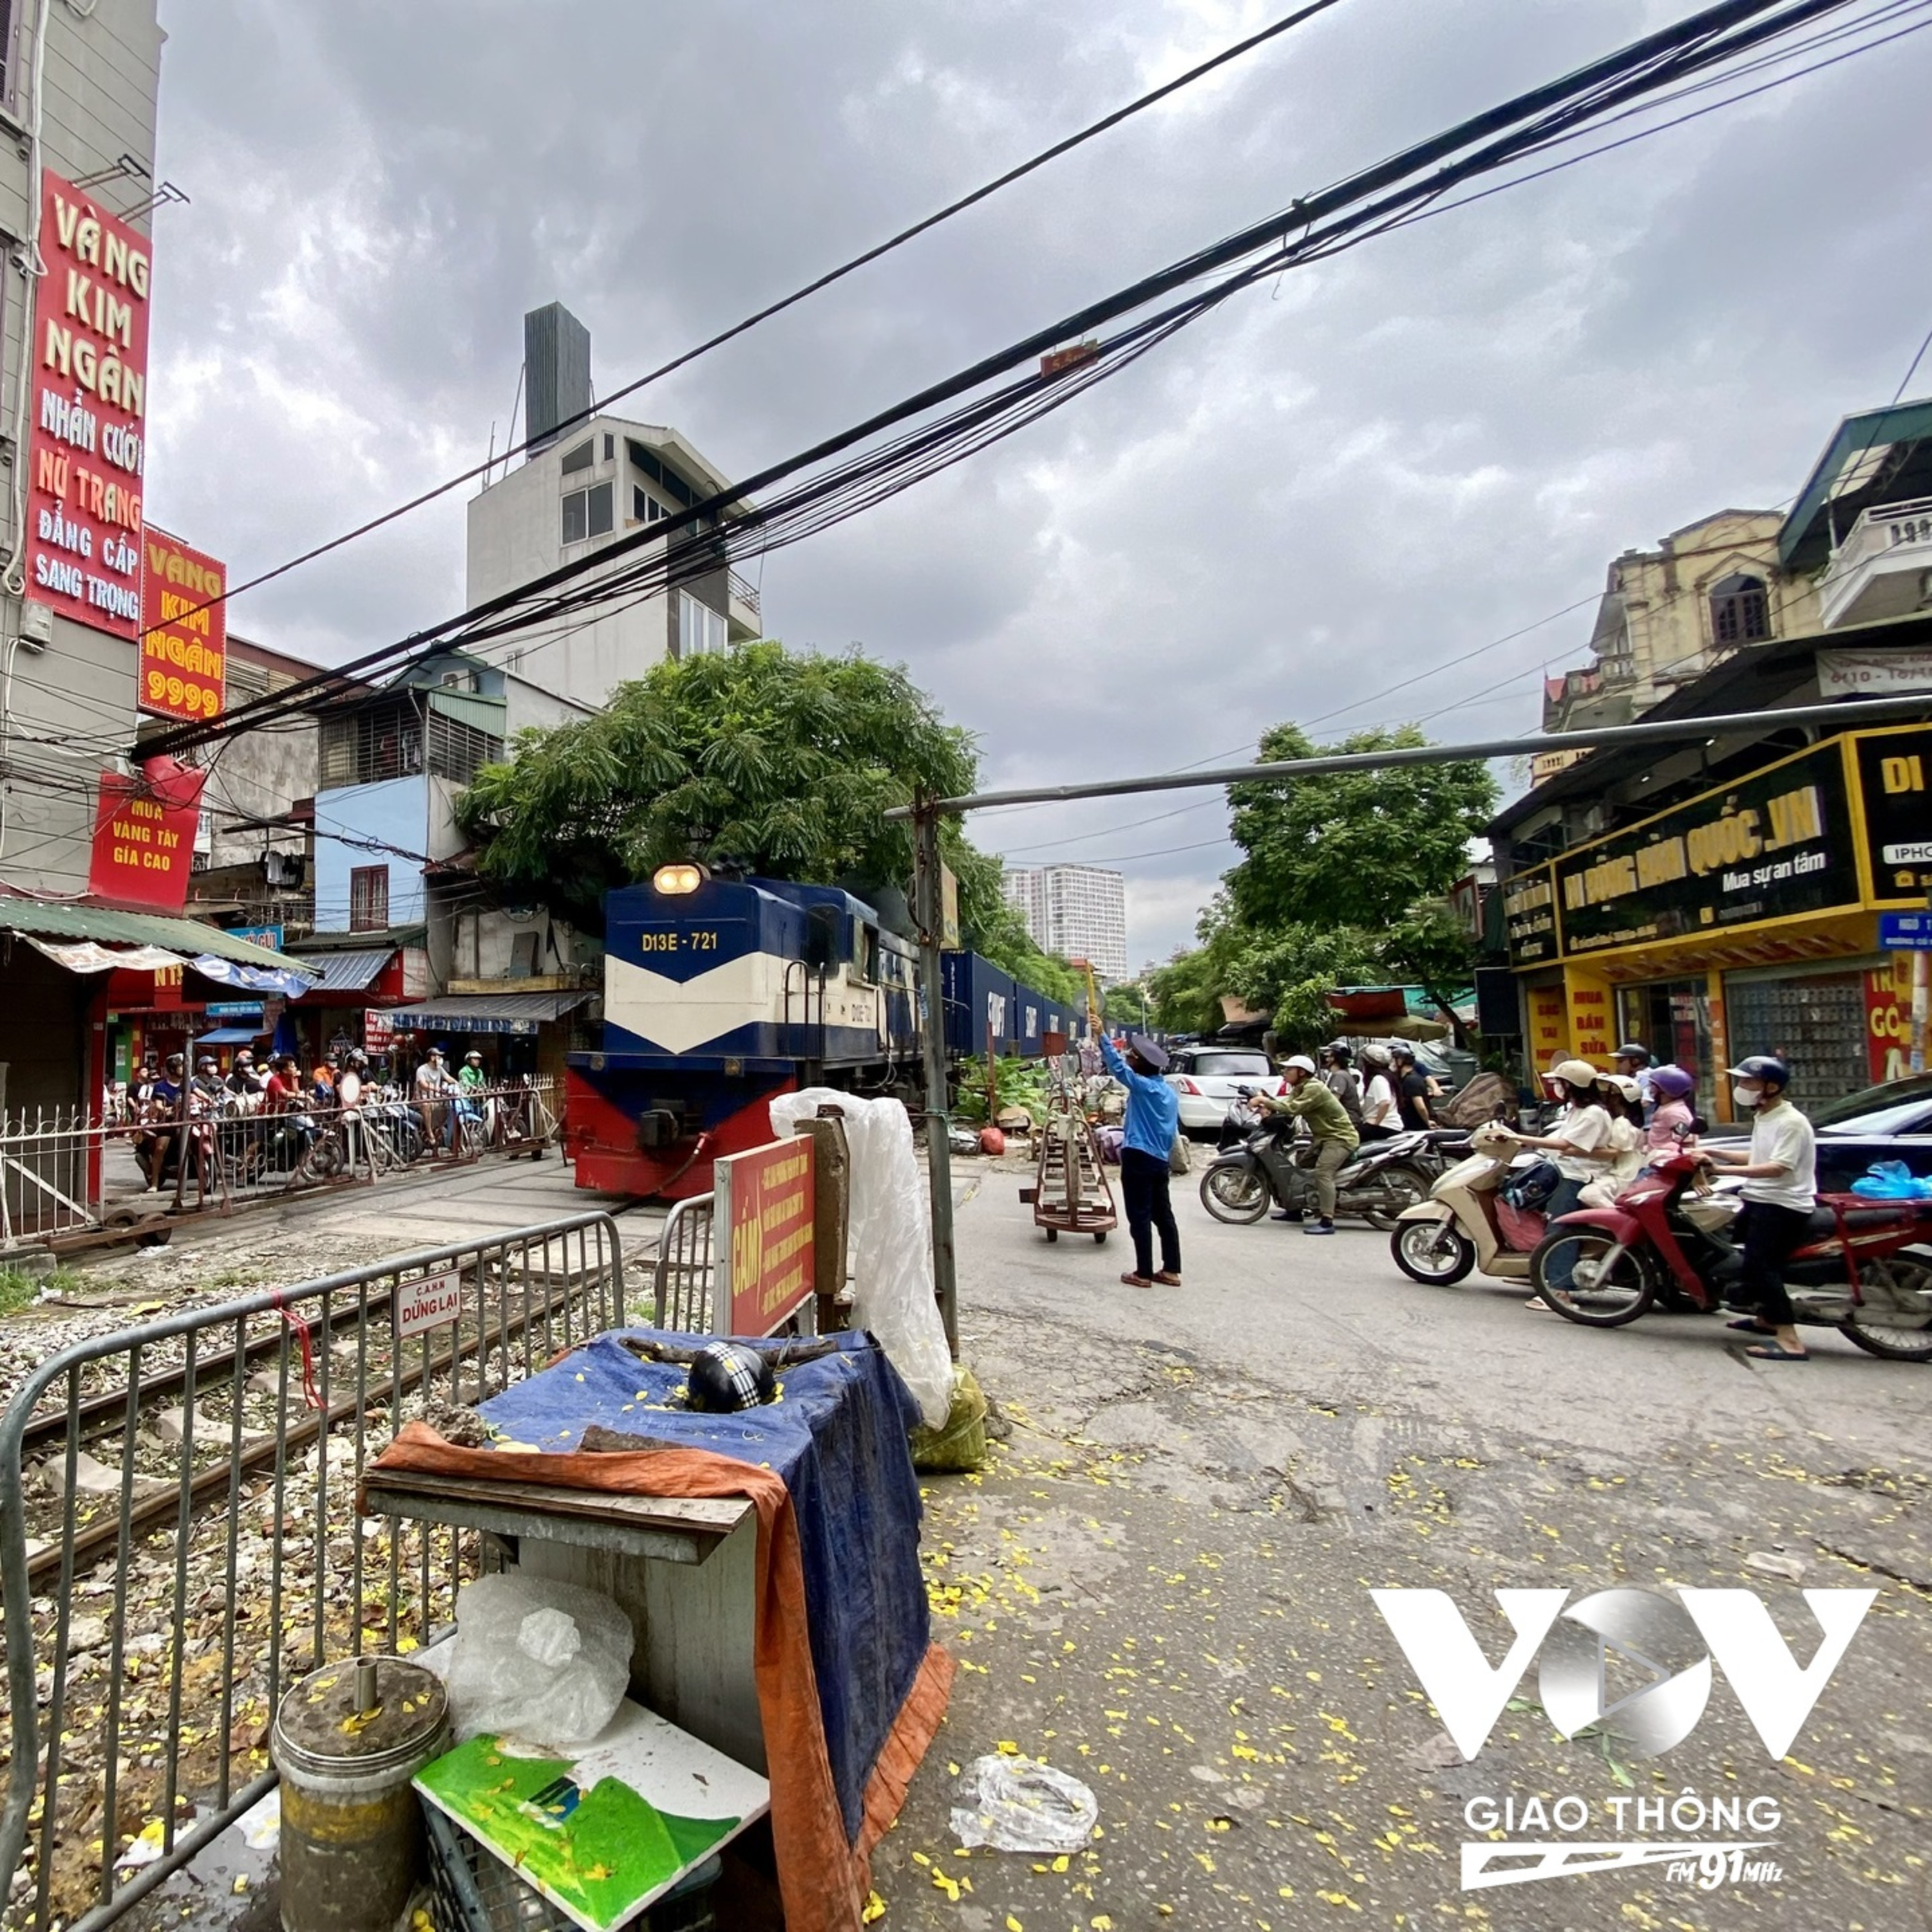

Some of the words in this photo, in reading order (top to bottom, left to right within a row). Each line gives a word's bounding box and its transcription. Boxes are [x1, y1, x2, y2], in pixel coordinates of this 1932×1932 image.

[53, 193, 149, 300] VÀNG
[66, 267, 131, 349] KIM
[45, 317, 144, 418] NGÂN
[76, 466, 141, 533] TRANG
[103, 531, 138, 576] CẤP
[147, 542, 222, 600] VÀNG
[35, 553, 83, 600] SANG
[86, 574, 139, 621] TRỌNG
[160, 589, 210, 637] KIM
[146, 627, 222, 681] NGÂN
[147, 670, 219, 719] 9999
[1880, 755, 1924, 793] DI
[131, 800, 163, 820] MUA
[113, 820, 151, 843] VÀNG
[156, 829, 179, 855] TÂY
[113, 845, 138, 866] GÍA
[143, 852, 170, 871] CAO
[1723, 871, 1750, 893] Mua
[1773, 862, 1792, 880] an
[1794, 851, 1826, 875] tâm
[642, 933, 677, 951] D13E
[691, 932, 717, 951] 721
[732, 1195, 758, 1298] CẤM
[402, 1299, 437, 1323] DỪNG
[439, 1292, 457, 1312] LẠI
